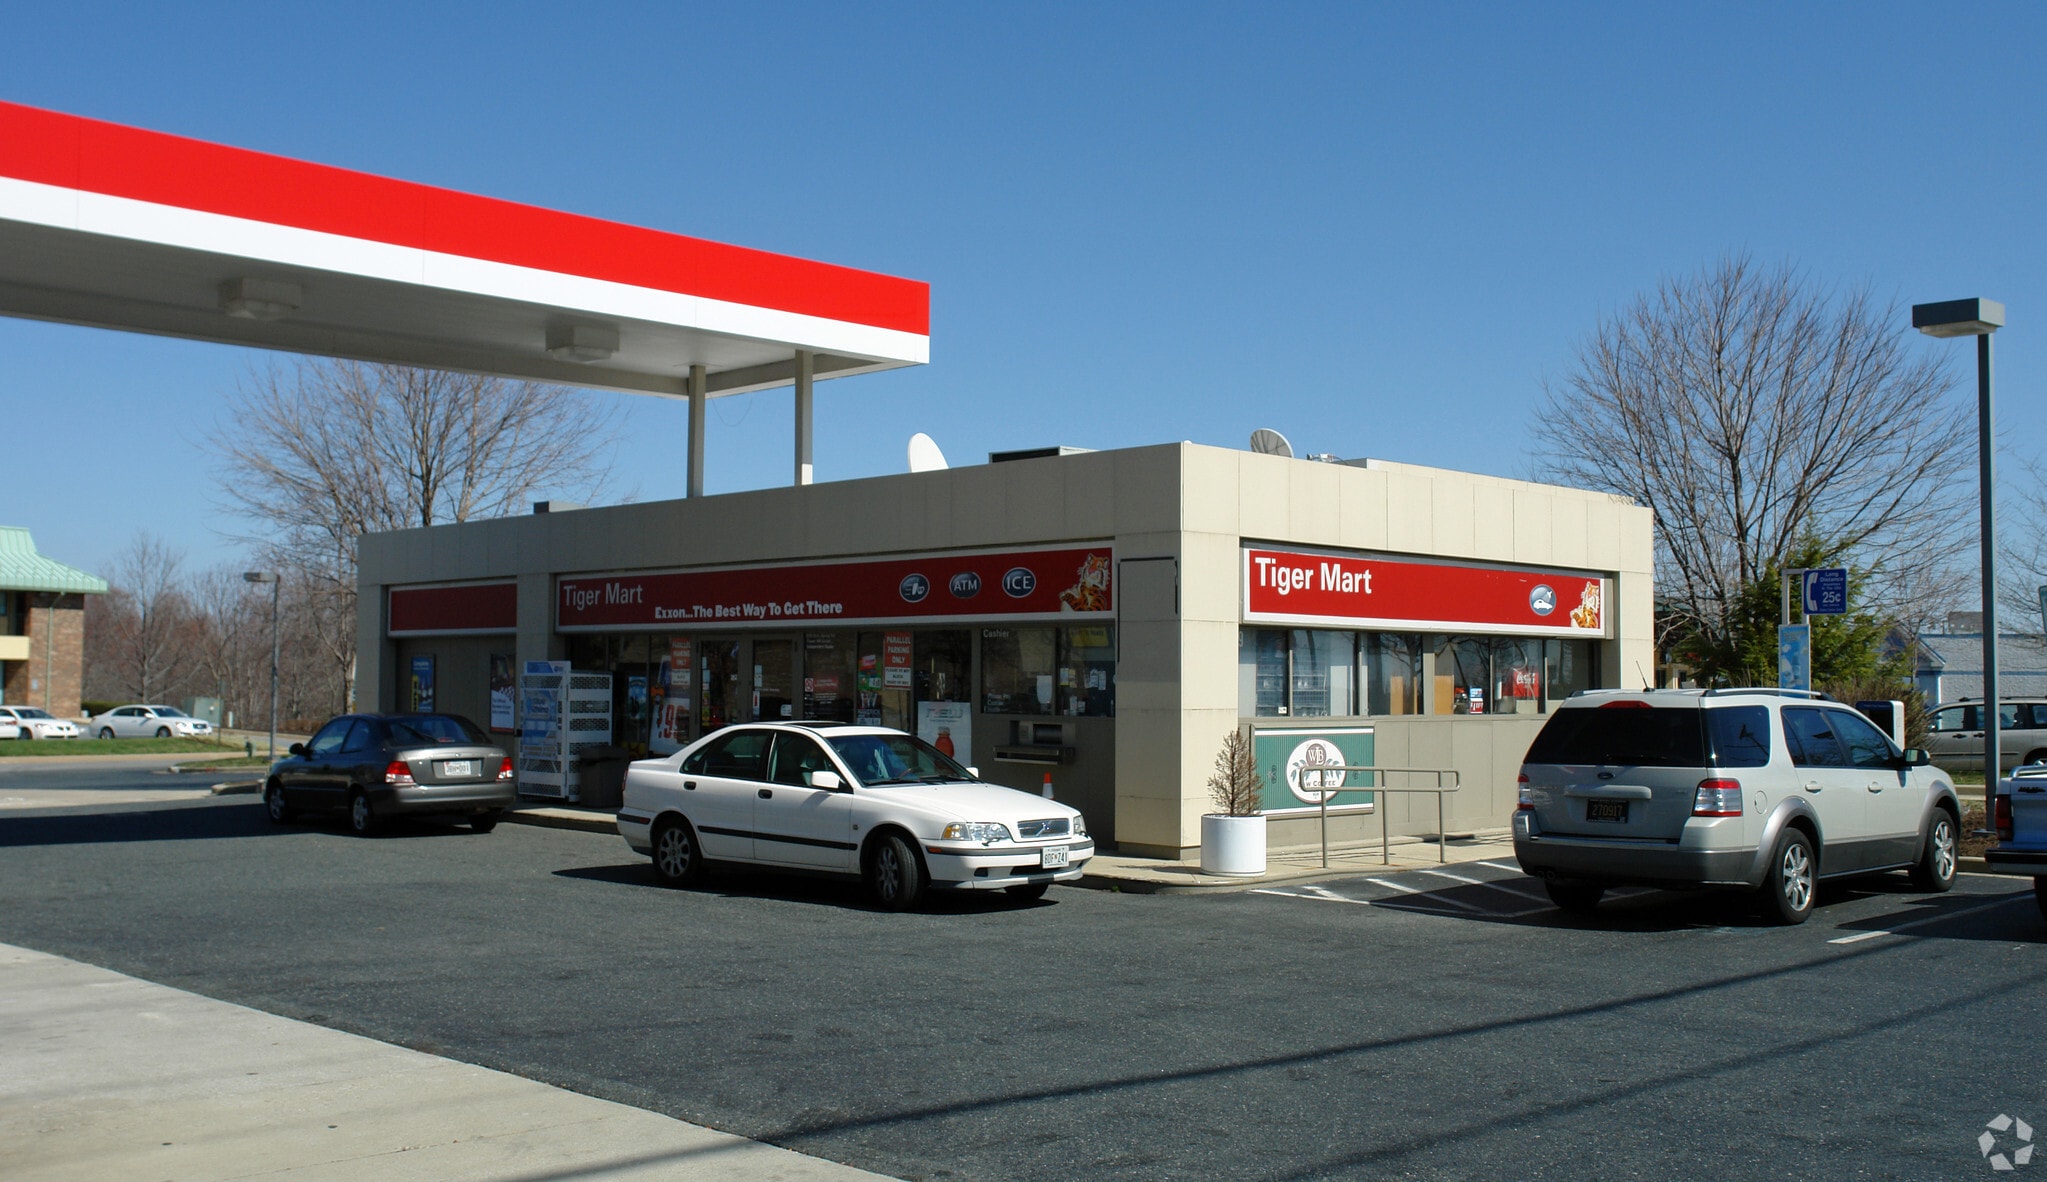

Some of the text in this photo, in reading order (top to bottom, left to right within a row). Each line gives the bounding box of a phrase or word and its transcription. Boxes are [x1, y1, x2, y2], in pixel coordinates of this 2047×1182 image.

[1006, 574, 1032, 590] ICE
[1255, 556, 1372, 595] Tiger Mart
[953, 578, 978, 591] ATM
[564, 582, 643, 611] Tiger Mart
[715, 604, 741, 618] Best
[743, 603, 767, 620] Way
[768, 602, 782, 616] To
[783, 601, 805, 615] Get
[806, 600, 843, 615] There
[983, 629, 1010, 638] Cashier
[891, 656, 905, 664] ONLY
[1592, 804, 1623, 817] 270917
